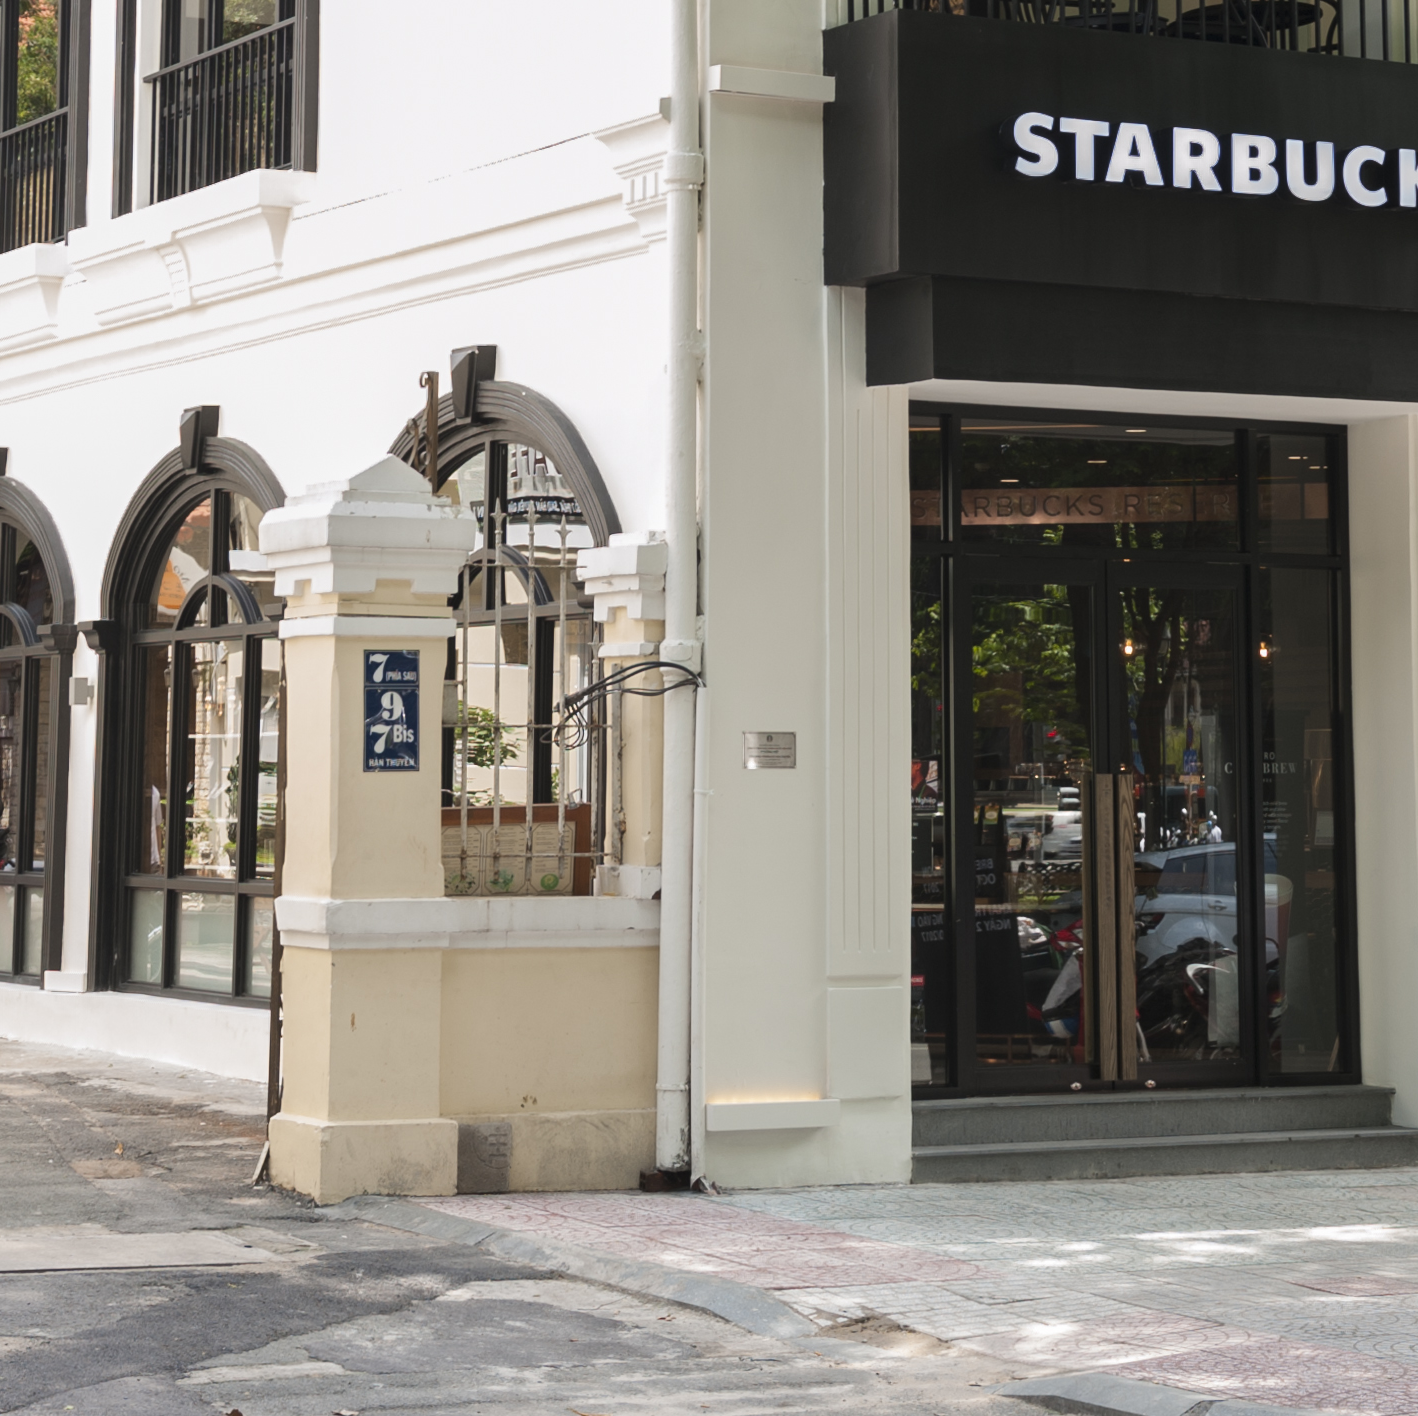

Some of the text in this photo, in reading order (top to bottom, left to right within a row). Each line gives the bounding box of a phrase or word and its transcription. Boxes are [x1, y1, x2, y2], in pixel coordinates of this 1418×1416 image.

[369, 653, 390, 683] 7
[381, 691, 403, 721] 9
[370, 724, 414, 754] 7 Bis
[1263, 762, 1297, 774] BREW
